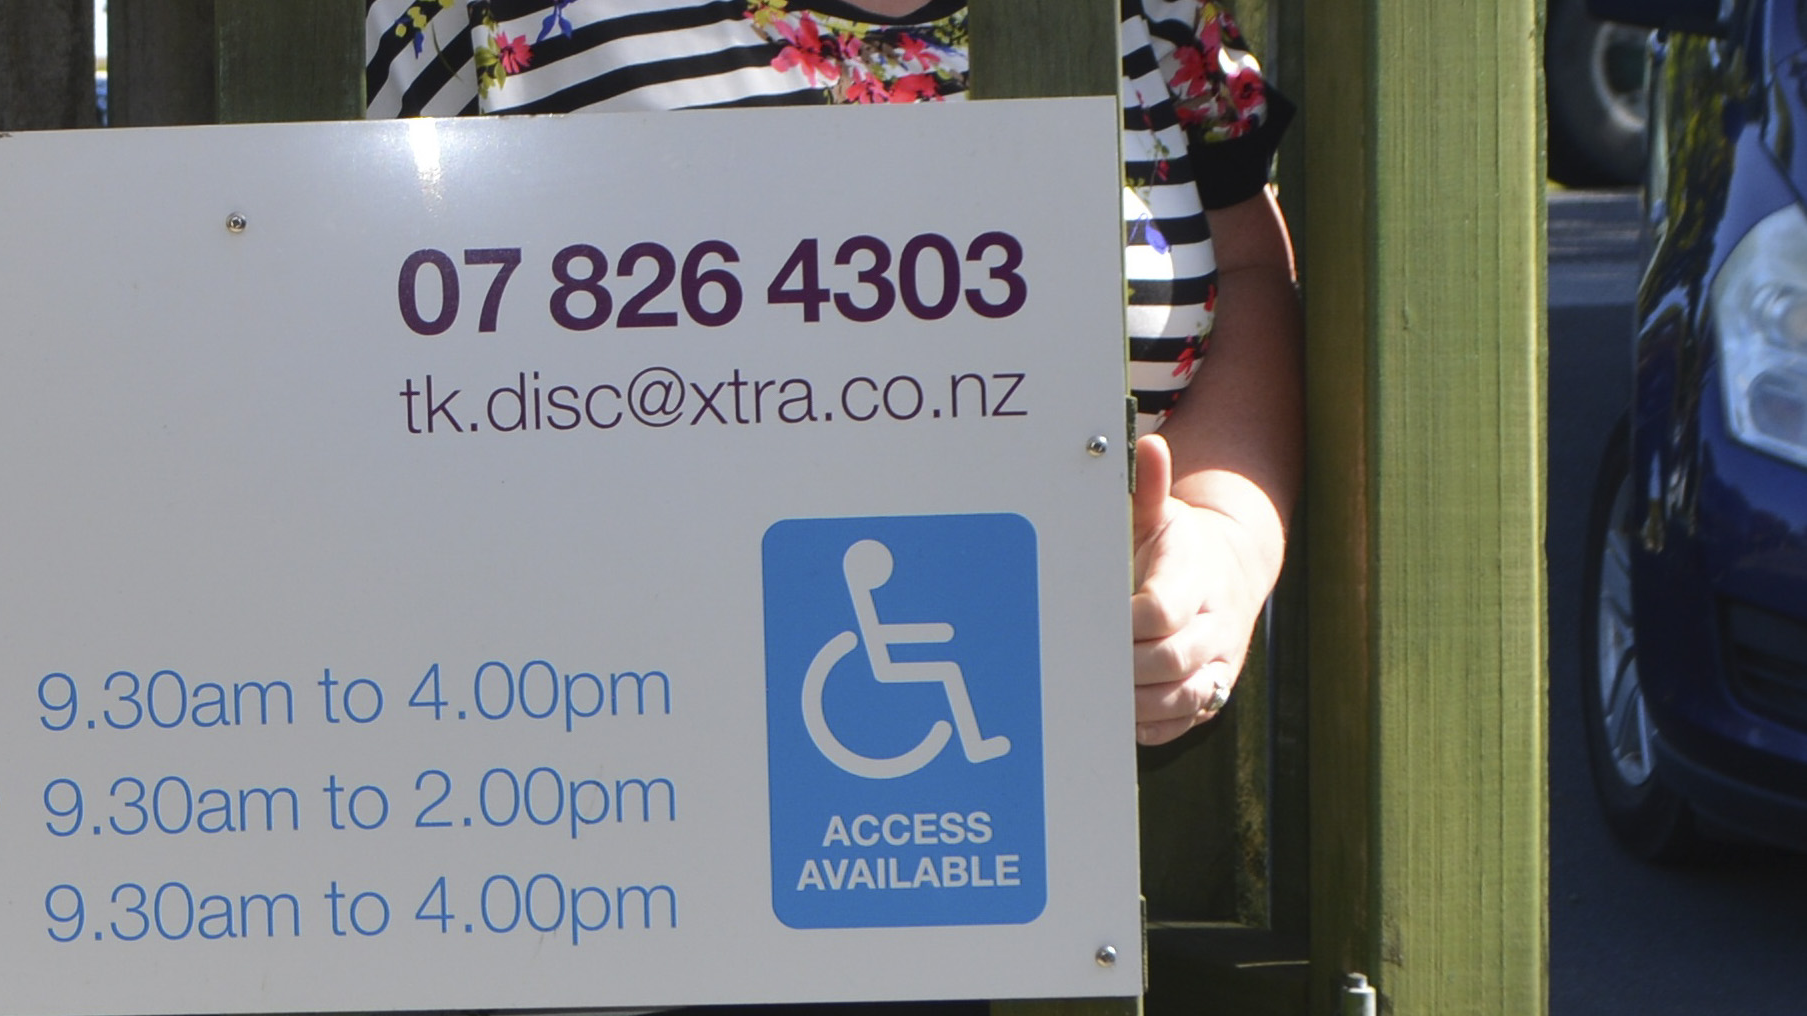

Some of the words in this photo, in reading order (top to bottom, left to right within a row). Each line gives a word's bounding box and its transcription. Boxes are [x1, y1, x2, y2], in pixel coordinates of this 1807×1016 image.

[398, 248, 521, 335] 07
[550, 240, 742, 331] 826
[767, 231, 1027, 322] 4303
[400, 367, 1027, 433] tk.disc@xtra.co.nz
[38, 670, 293, 730] 9.30am
[318, 669, 383, 723] to
[409, 660, 670, 732] 4.00pm
[44, 776, 298, 836] 9.30am
[323, 775, 388, 829] to
[416, 767, 675, 839] 2.00pm
[823, 812, 992, 846] ACCESS
[797, 855, 1020, 890] AVAILABLE
[45, 882, 299, 942] 9.30am
[325, 881, 389, 936] to
[415, 874, 676, 945] 4.00pm
